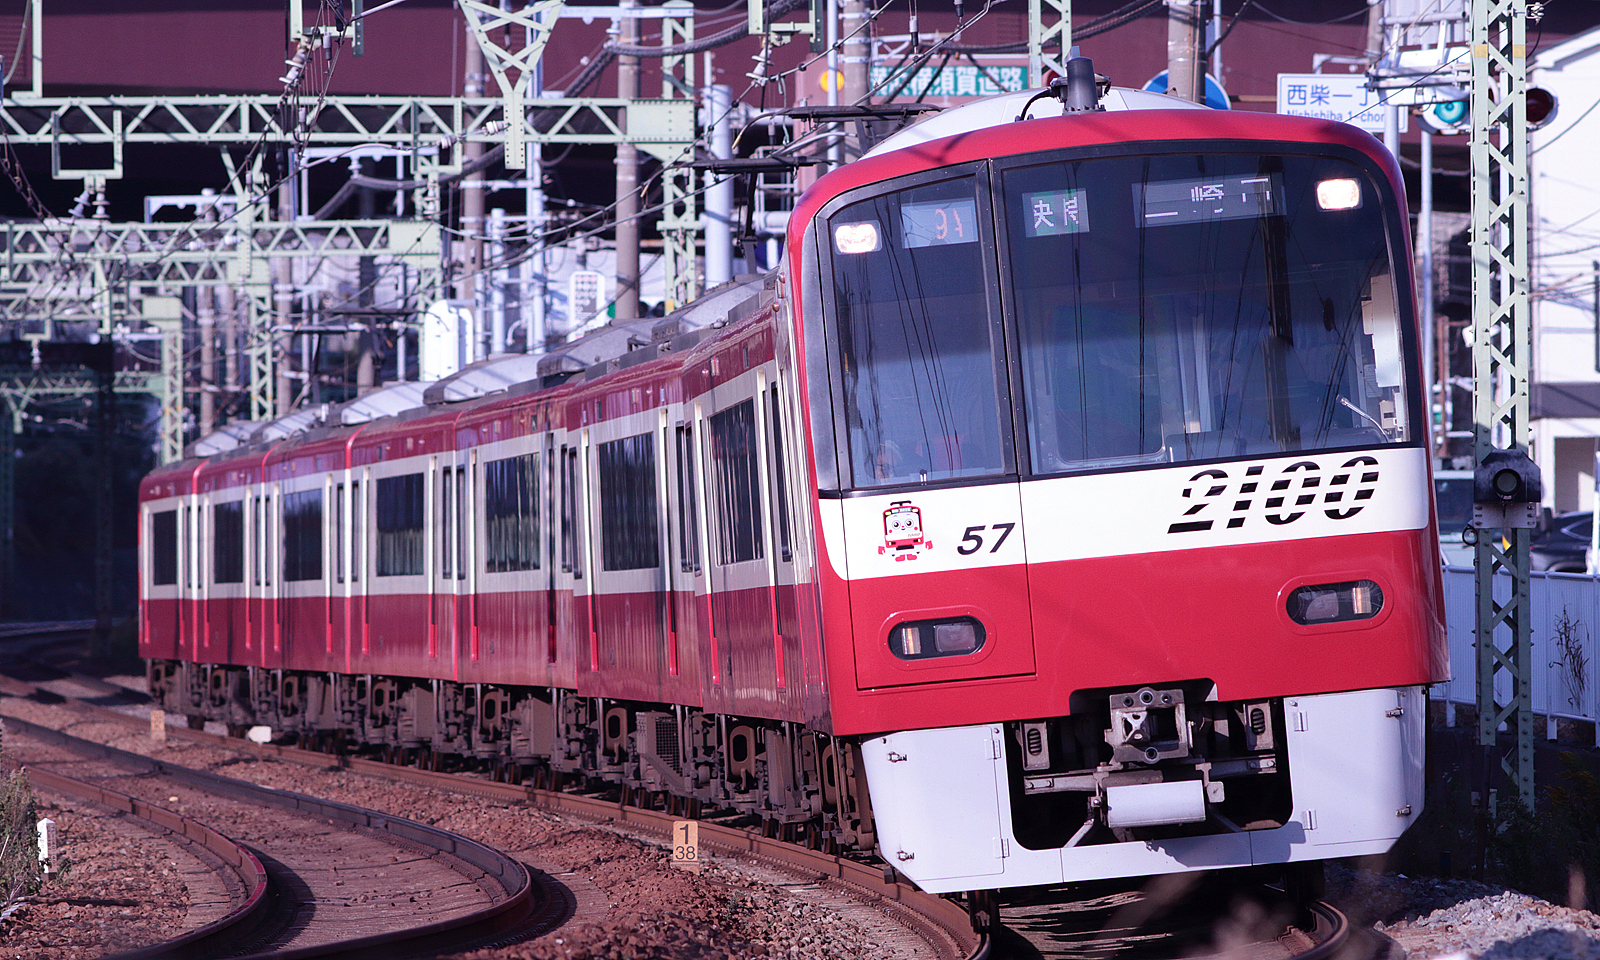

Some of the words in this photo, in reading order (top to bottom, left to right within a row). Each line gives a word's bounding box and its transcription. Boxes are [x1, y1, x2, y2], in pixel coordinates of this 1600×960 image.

[1287, 84, 1385, 106] 西柴一丁
[1167, 456, 1379, 534] 2100
[957, 522, 1016, 555] 57
[679, 823, 689, 845] 1
[675, 845, 696, 860] 38
